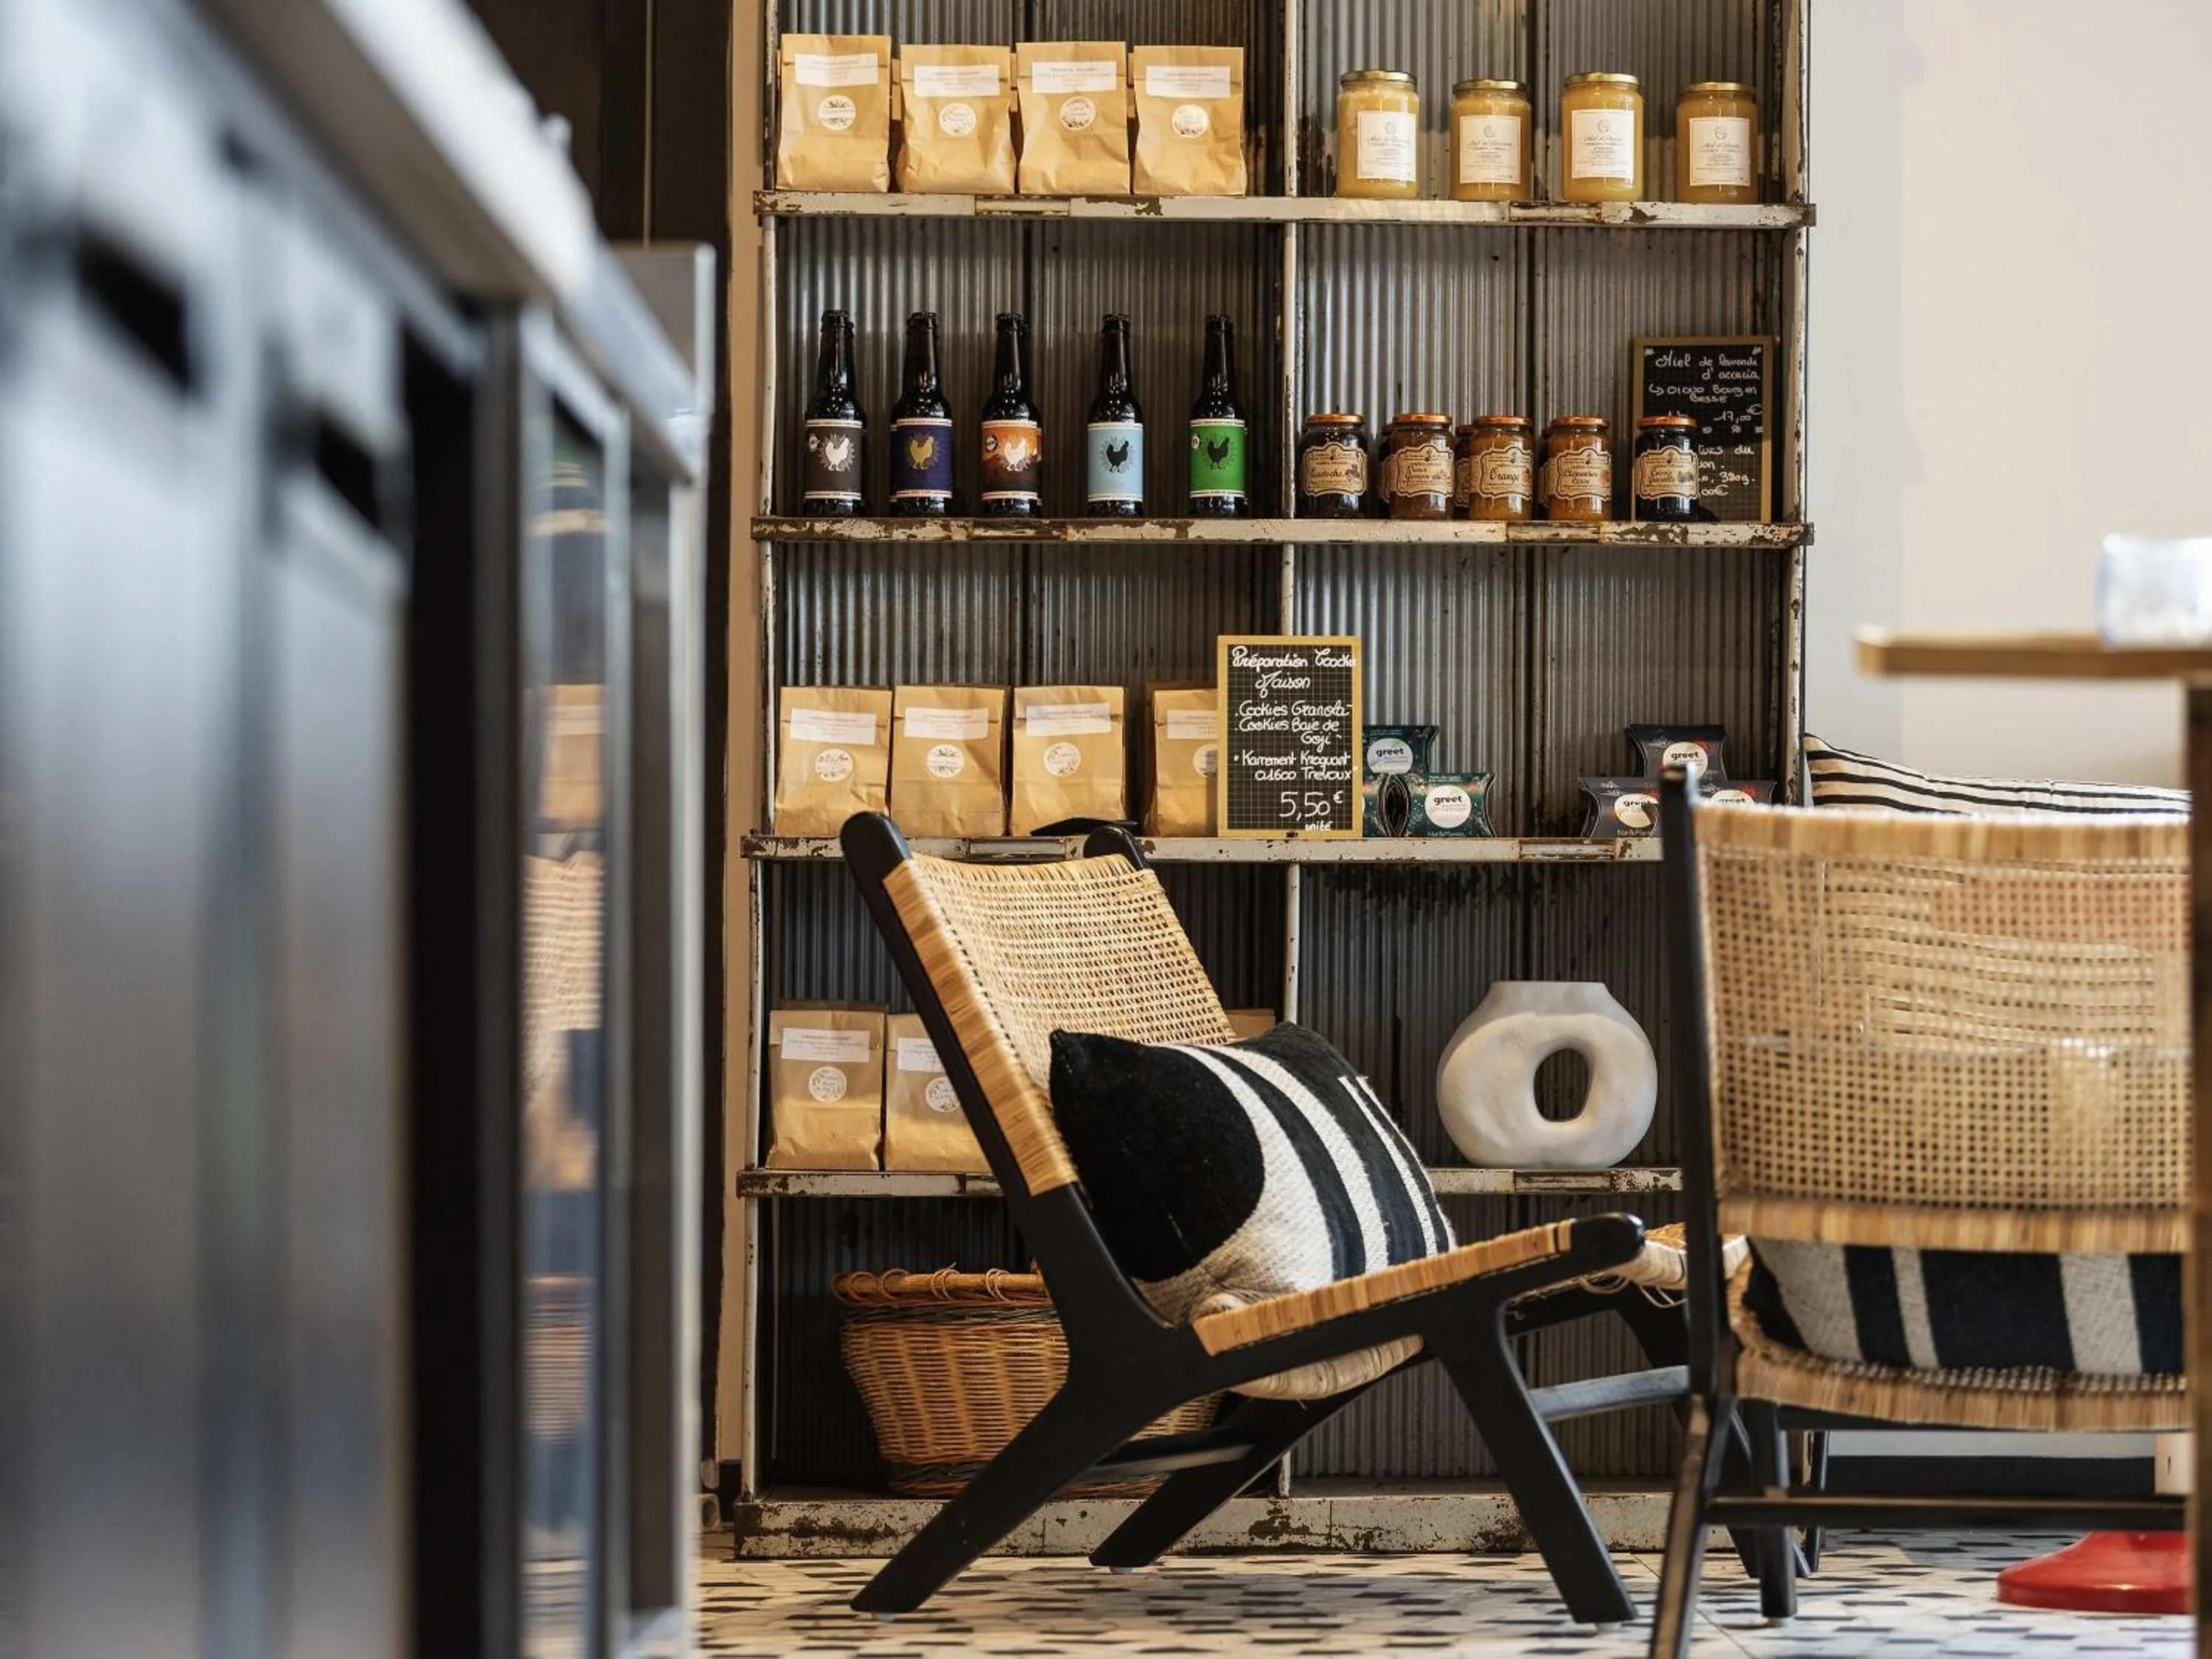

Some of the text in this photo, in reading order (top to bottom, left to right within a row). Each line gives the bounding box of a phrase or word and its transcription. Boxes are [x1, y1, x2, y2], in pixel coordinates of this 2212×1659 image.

[1699, 356, 1713, 366] de
[1232, 646, 1308, 672] Préparation
[1255, 670, 1310, 698] Maison
[1239, 700, 1350, 717] Cookies Granola
[1239, 717, 1340, 731] Cookies Baie de
[1301, 731, 1331, 752] Goji
[1376, 748, 1405, 758] greet
[1671, 751, 1700, 761] greet
[1255, 768, 1296, 780] 01600
[1433, 796, 1462, 806] greet
